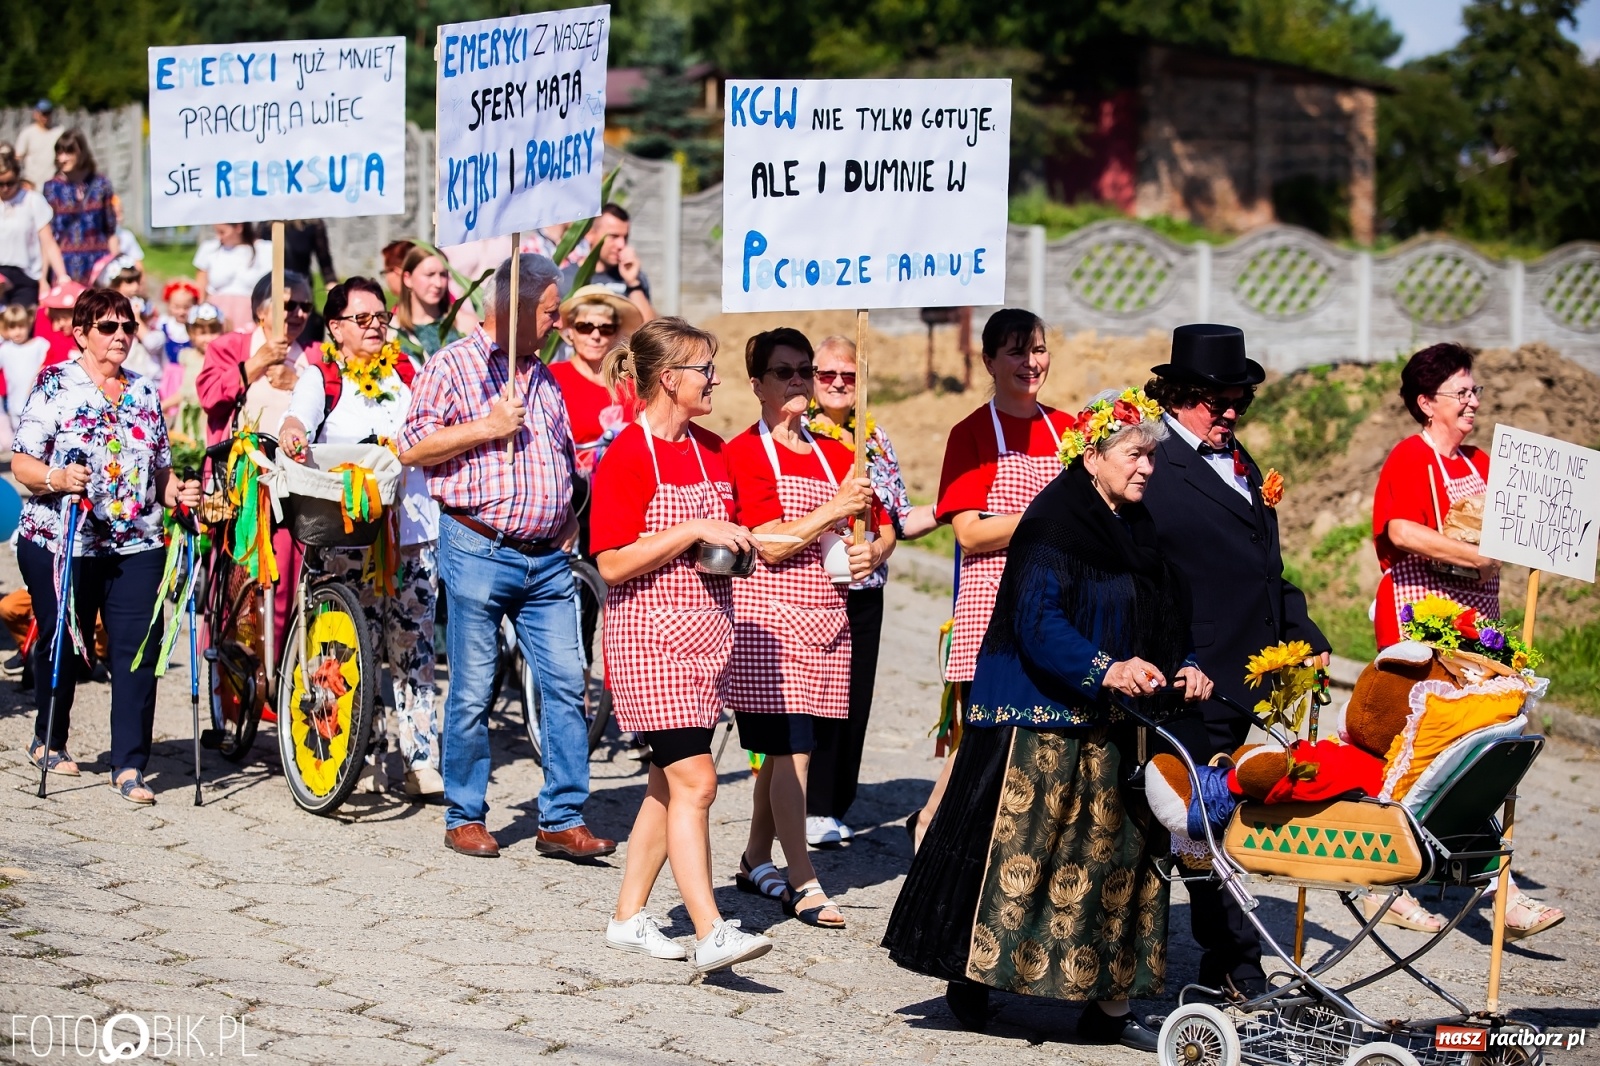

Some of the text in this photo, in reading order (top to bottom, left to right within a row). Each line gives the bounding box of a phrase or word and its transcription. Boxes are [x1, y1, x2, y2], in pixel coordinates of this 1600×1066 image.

[156, 45, 395, 90] EMERYCI JUŻ MNIEJ
[444, 18, 605, 78] EMERYCI Z NASZEJ
[289, 100, 303, 130] A
[311, 92, 364, 127] WIĘC
[468, 81, 527, 131] SFERY
[731, 85, 798, 129] KGW
[811, 107, 844, 131] NIE
[856, 107, 912, 131] TYLKO
[164, 152, 386, 203] SIĘ RELAKSUJĄ
[447, 126, 596, 231] KIJKI I ROWERY
[751, 158, 967, 199] ALE I DUMNIE W
[886, 248, 986, 287] PARADUJE
[1498, 433, 1588, 480] EMERYCI NIE
[1494, 490, 1527, 519] ALE
